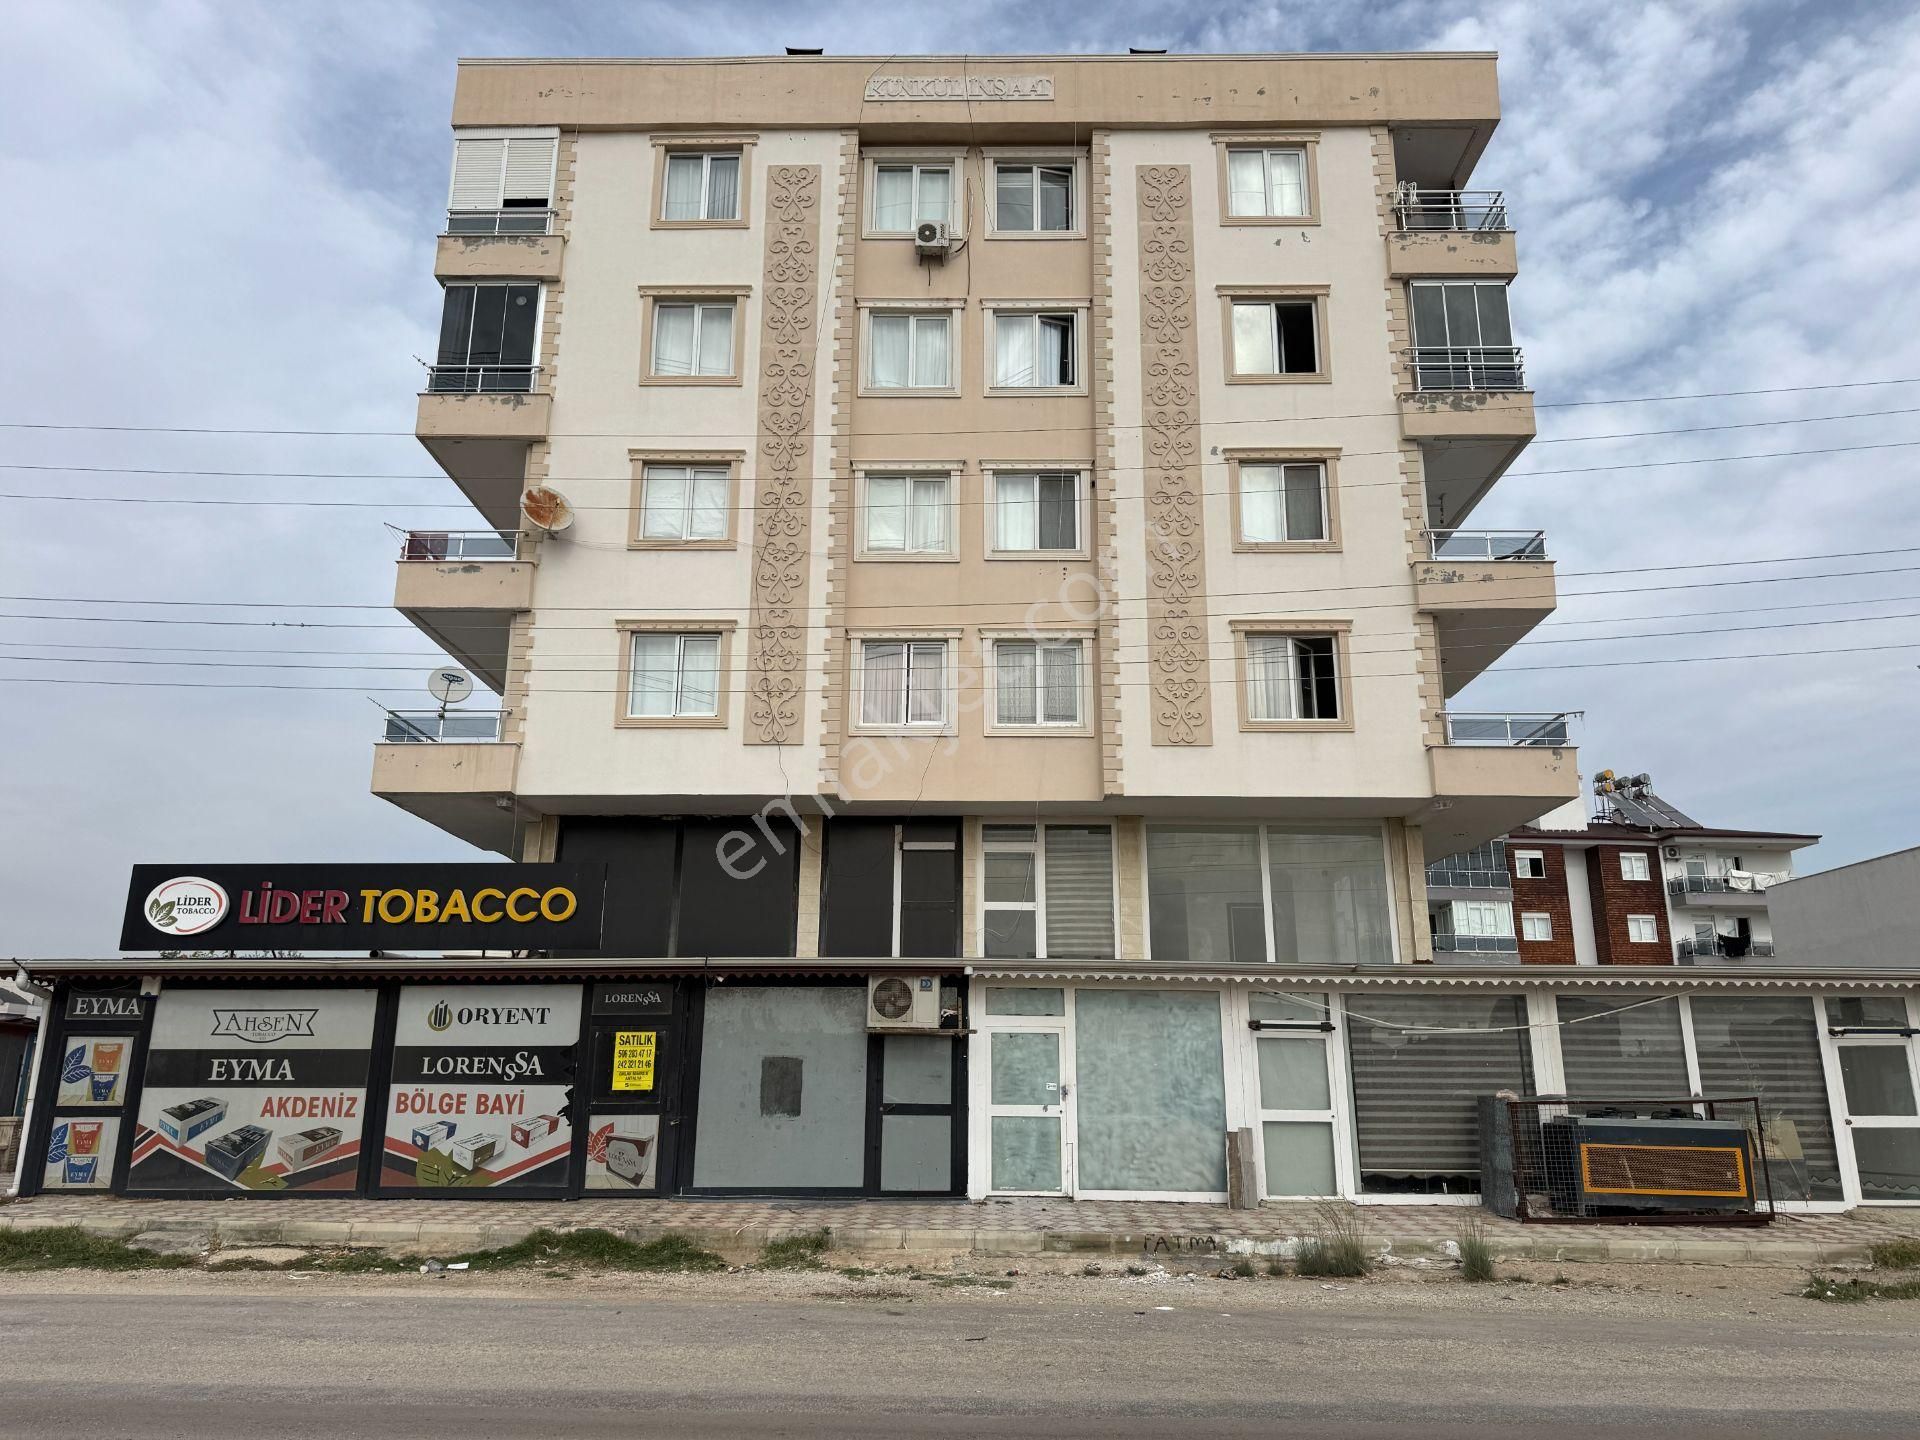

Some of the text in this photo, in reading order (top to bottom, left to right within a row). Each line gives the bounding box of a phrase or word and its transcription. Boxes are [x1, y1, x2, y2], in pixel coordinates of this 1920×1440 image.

[176, 894, 212, 906] LİDER
[239, 881, 578, 924] LİDER TOBACCO
[177, 907, 216, 915] TOBACCO
[73, 997, 141, 1015] EYMA
[605, 990, 662, 1006] LORENSSA
[457, 1007, 551, 1025] ORYENT
[618, 1034, 653, 1046] SATILIK
[207, 1058, 295, 1081] EYMA
[420, 1051, 545, 1082] LORENSSA
[260, 1092, 358, 1118] AKDENİZ
[395, 1088, 525, 1115] BÖLGE BAYİ
